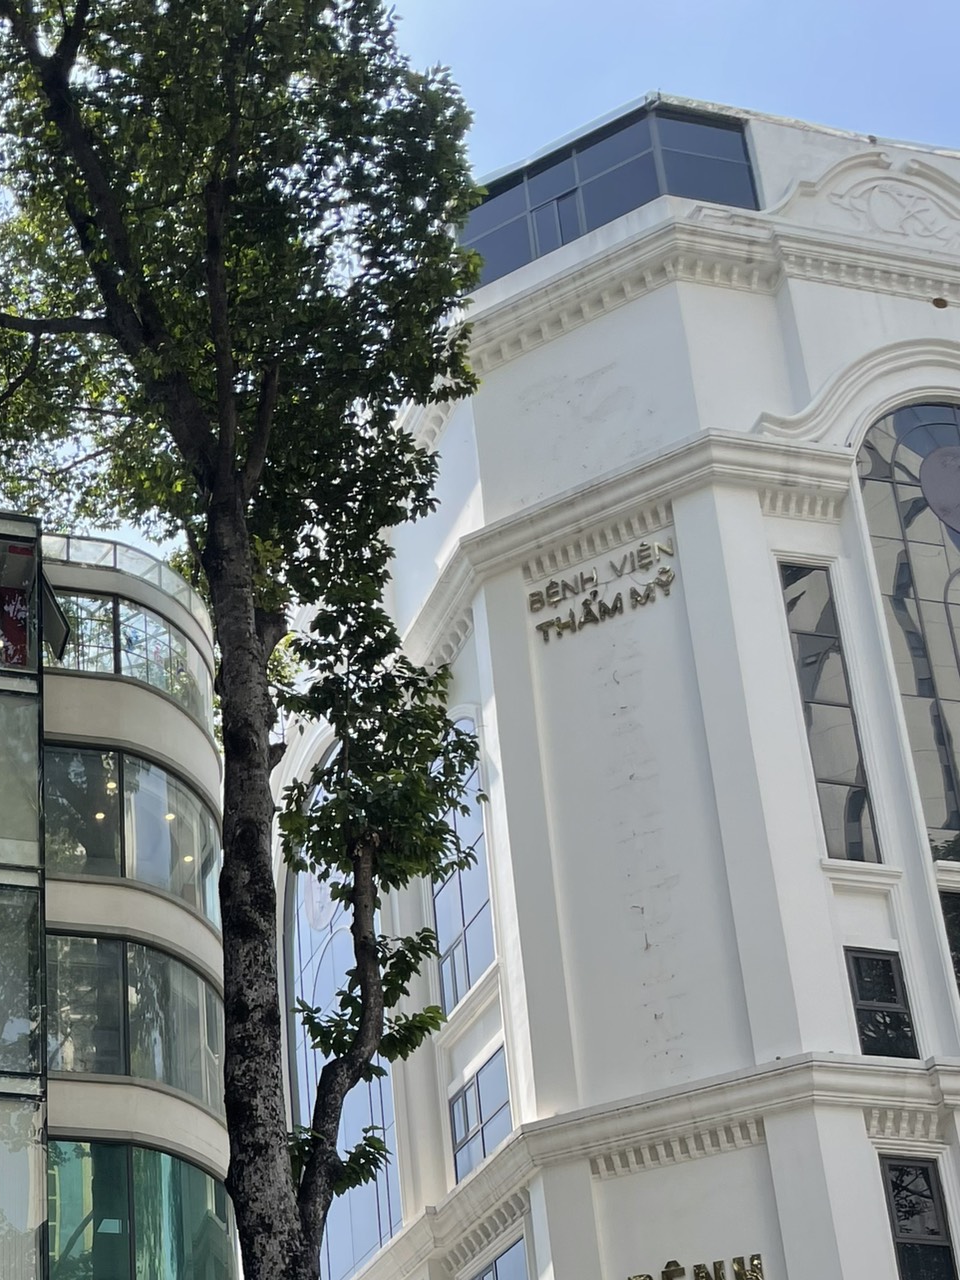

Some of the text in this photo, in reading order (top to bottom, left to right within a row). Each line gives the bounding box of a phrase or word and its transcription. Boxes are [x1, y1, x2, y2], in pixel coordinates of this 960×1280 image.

[528, 537, 674, 614] BỆNH VIỆN
[535, 565, 676, 645] THẨM MỸ
